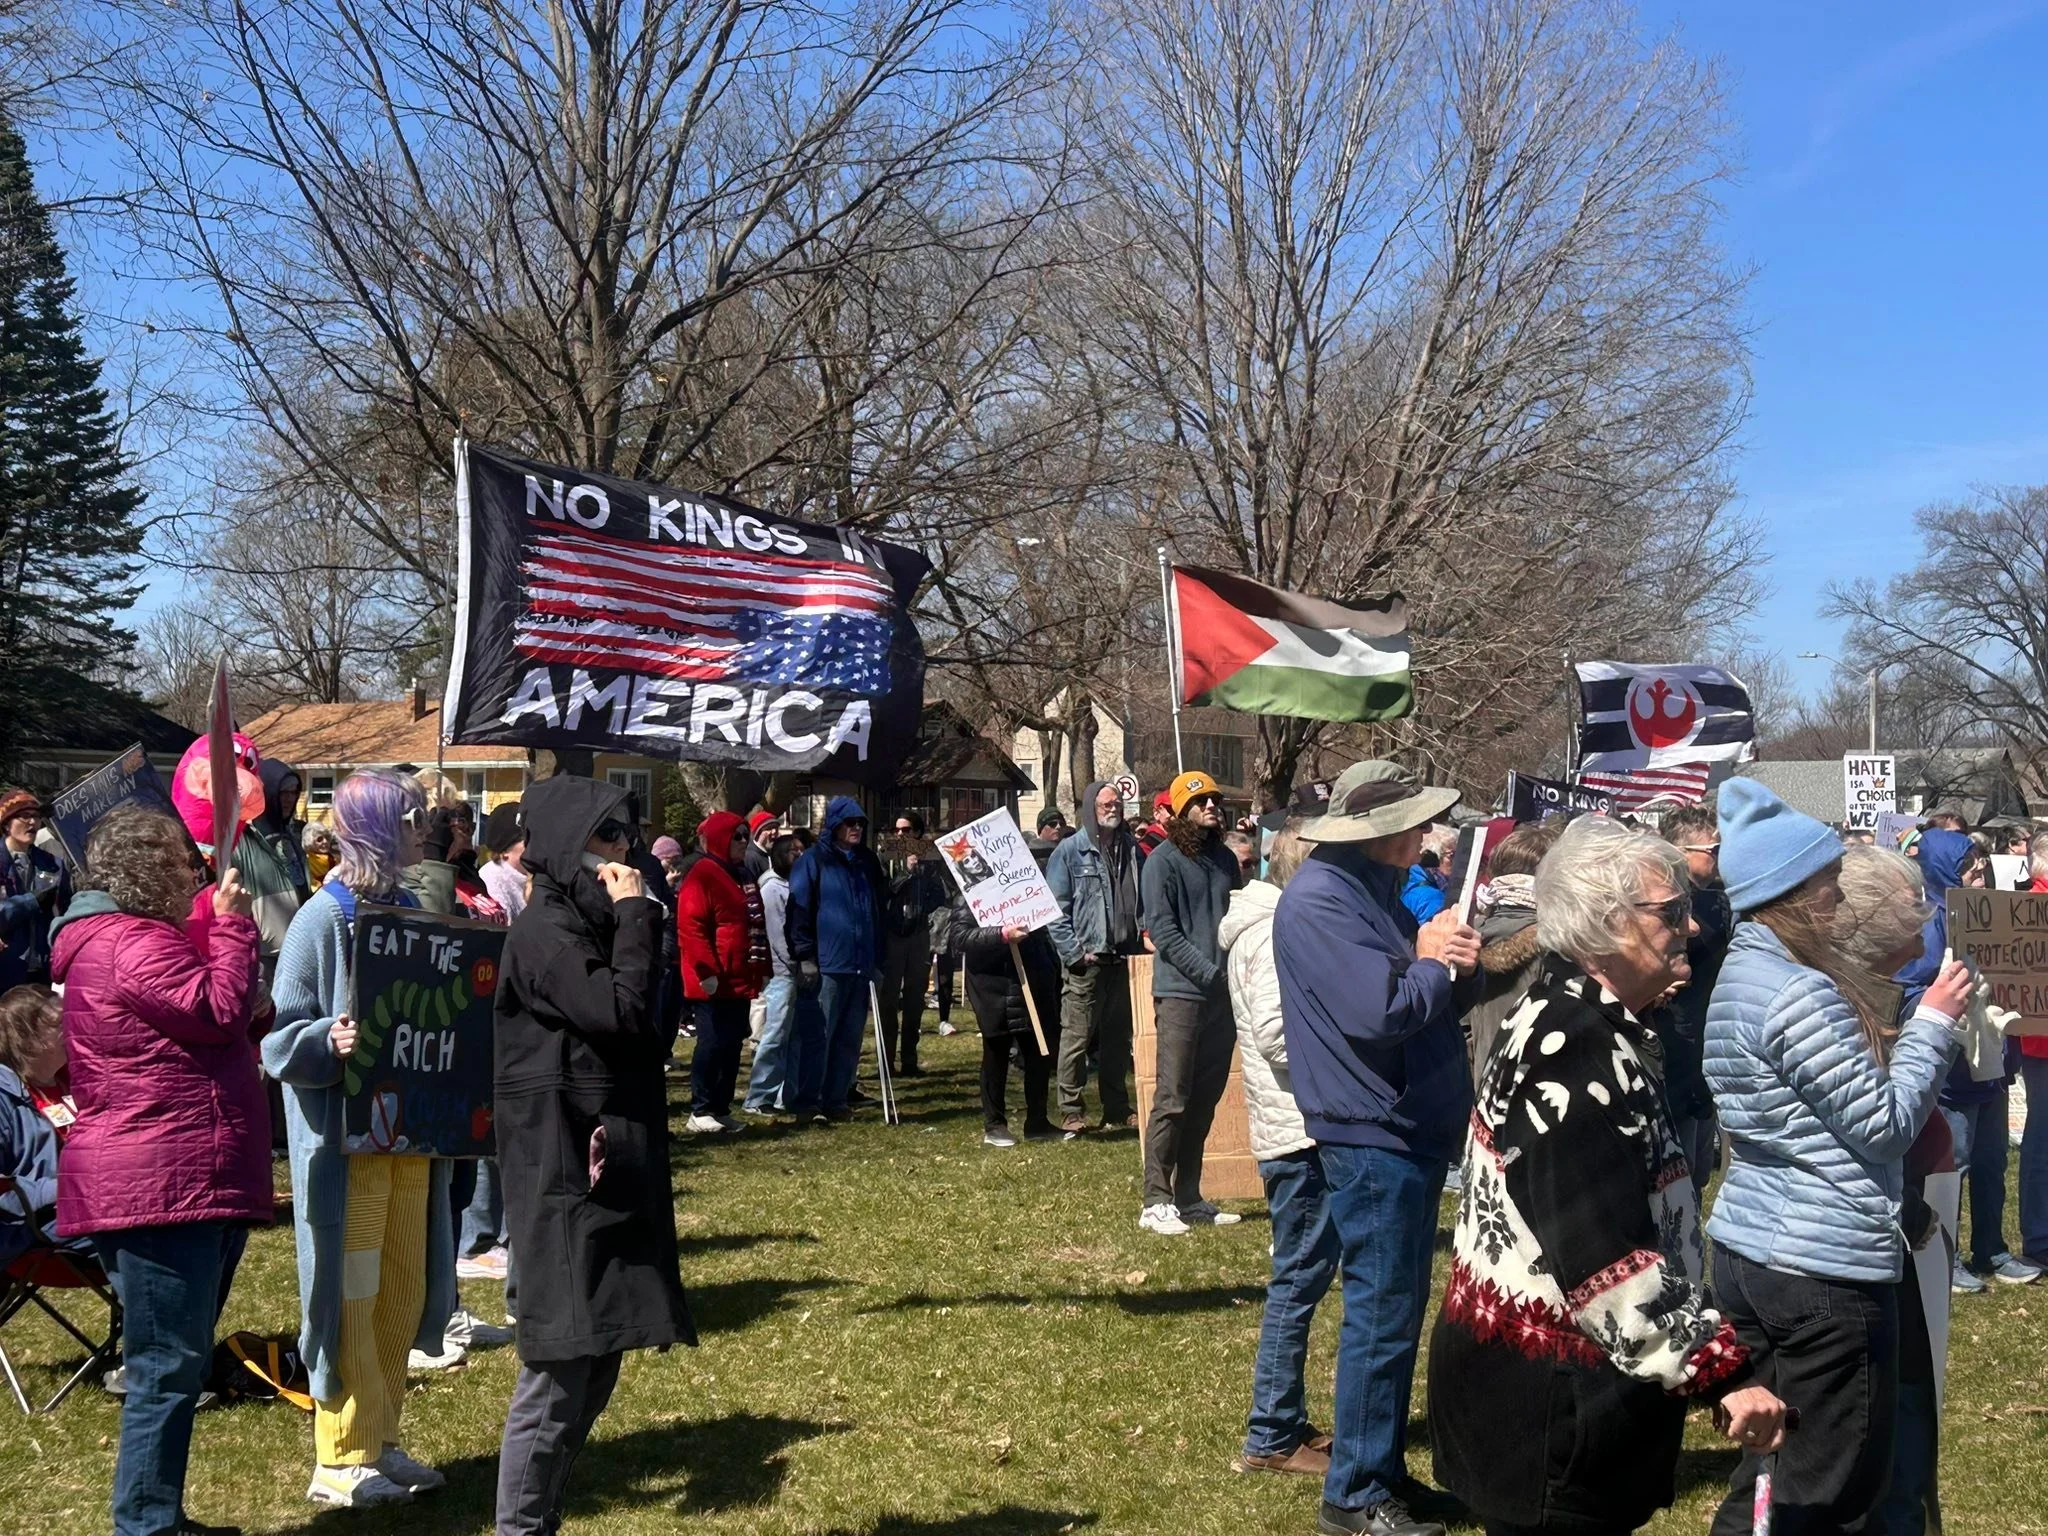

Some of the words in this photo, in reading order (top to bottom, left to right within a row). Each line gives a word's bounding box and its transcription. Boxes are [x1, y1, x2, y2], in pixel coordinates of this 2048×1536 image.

[524, 475, 610, 529] NO
[648, 495, 807, 555] KINGS
[499, 667, 872, 761] AMERICA
[1849, 760, 1890, 776] HATE
[55, 787, 90, 820] DOES
[81, 786, 114, 823] MAKE
[119, 774, 136, 797] MY
[1533, 785, 1559, 803] NO
[1857, 790, 1896, 802] CHOICE
[971, 824, 990, 839] No
[981, 832, 1016, 859] Kings
[992, 859, 1009, 874] No
[998, 865, 1036, 886] Queens
[1966, 895, 1992, 930] NO
[369, 925, 420, 956] EAT
[428, 934, 463, 974] THE
[393, 1023, 455, 1073] RICH
